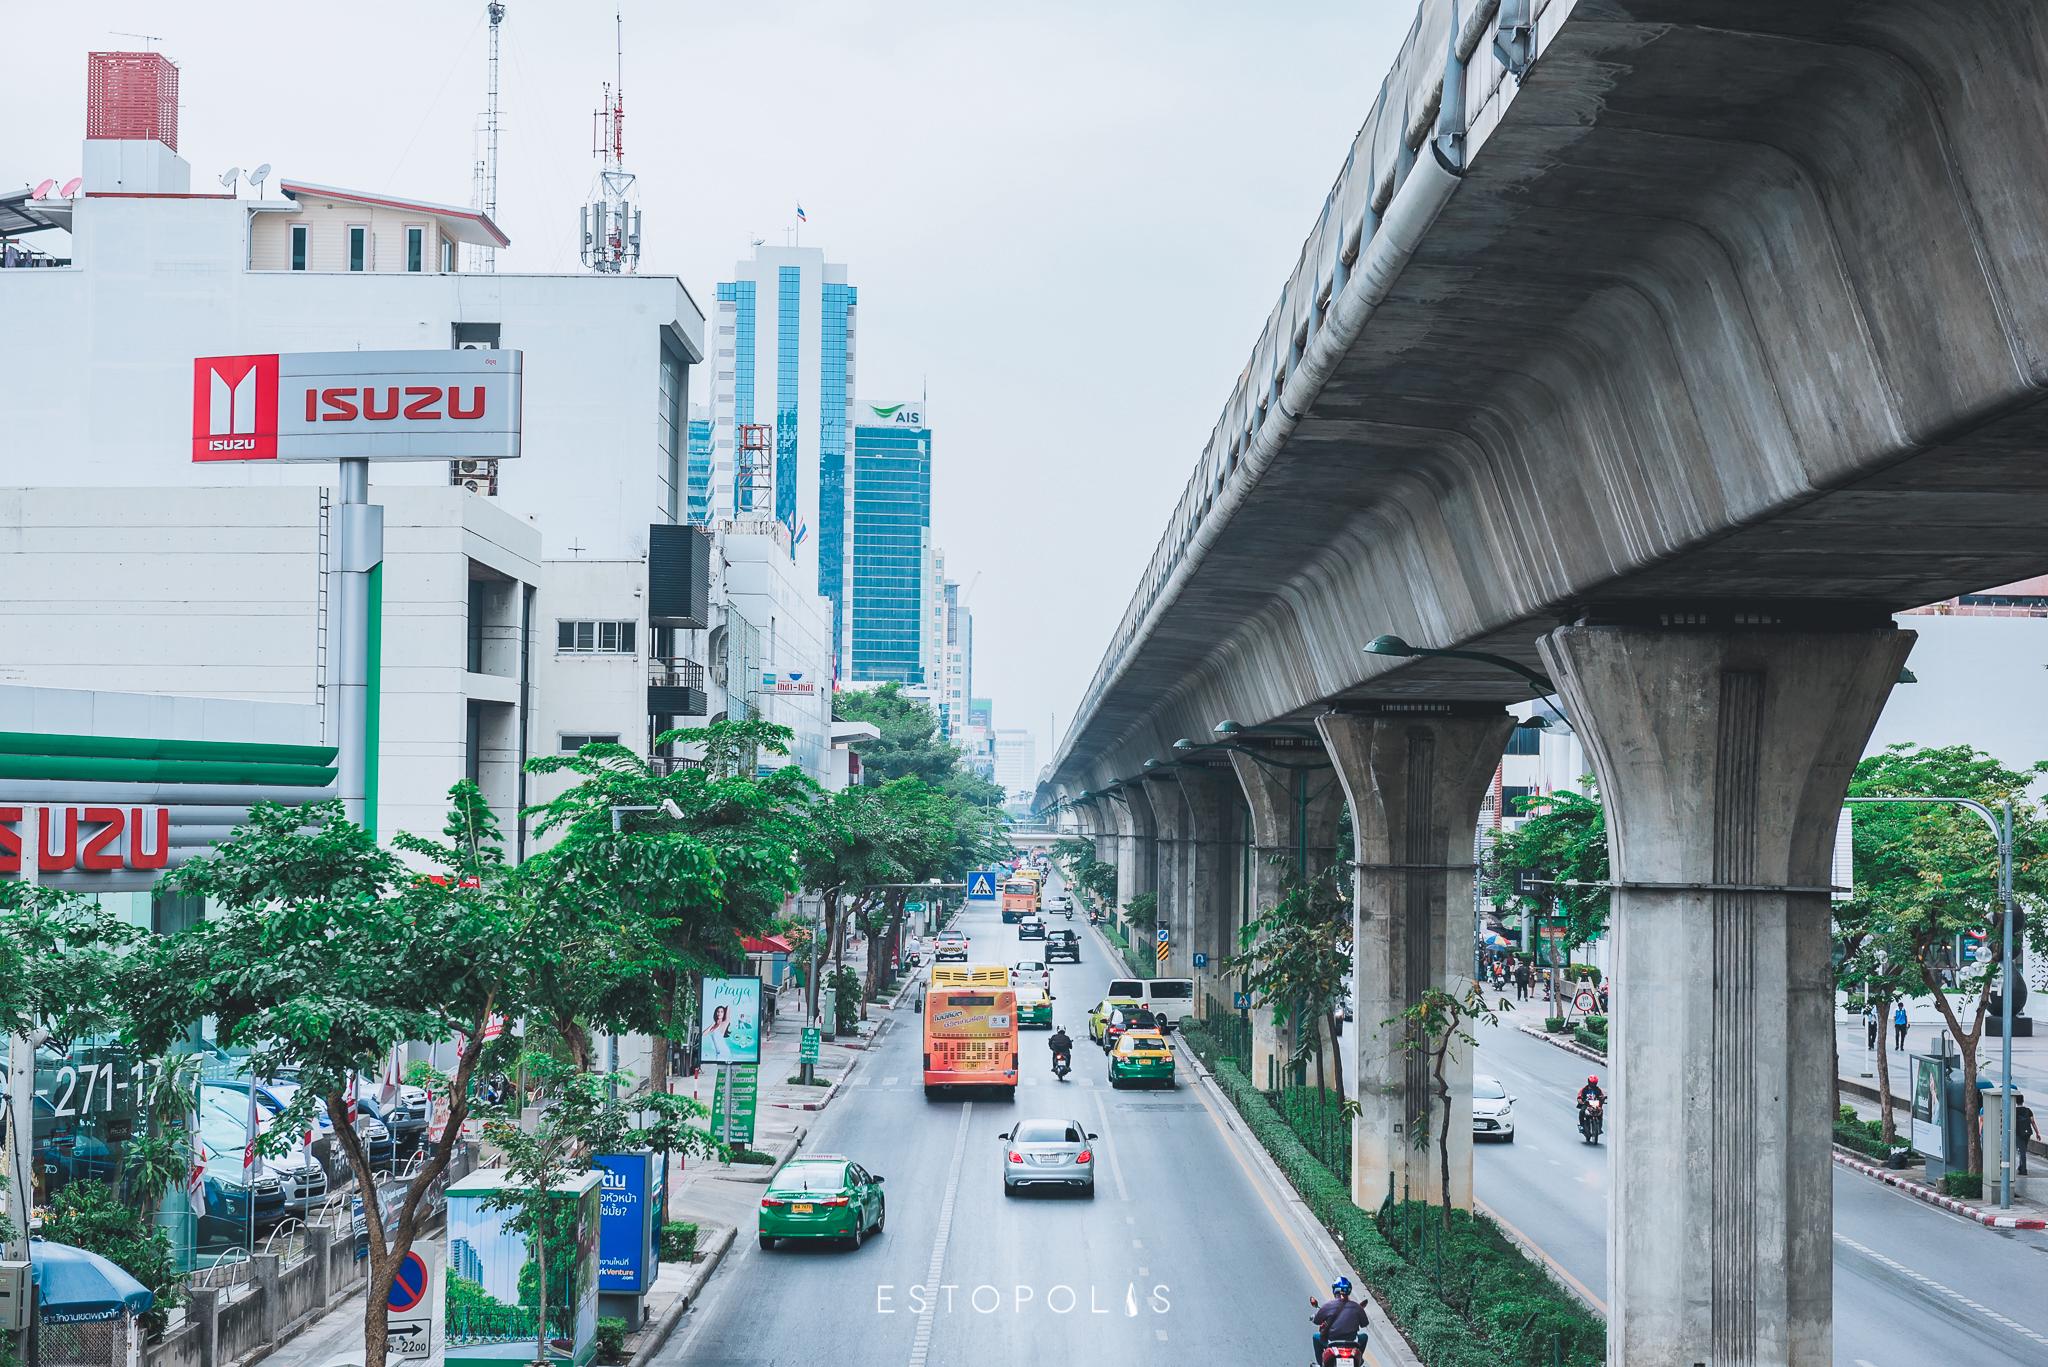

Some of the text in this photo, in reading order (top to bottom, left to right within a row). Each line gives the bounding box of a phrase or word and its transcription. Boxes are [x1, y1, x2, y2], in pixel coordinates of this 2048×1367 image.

[306, 386, 486, 422] ISUZU
[896, 412, 919, 423] AIS
[209, 439, 255, 451] ISUZU
[714, 982, 752, 1005] praya
